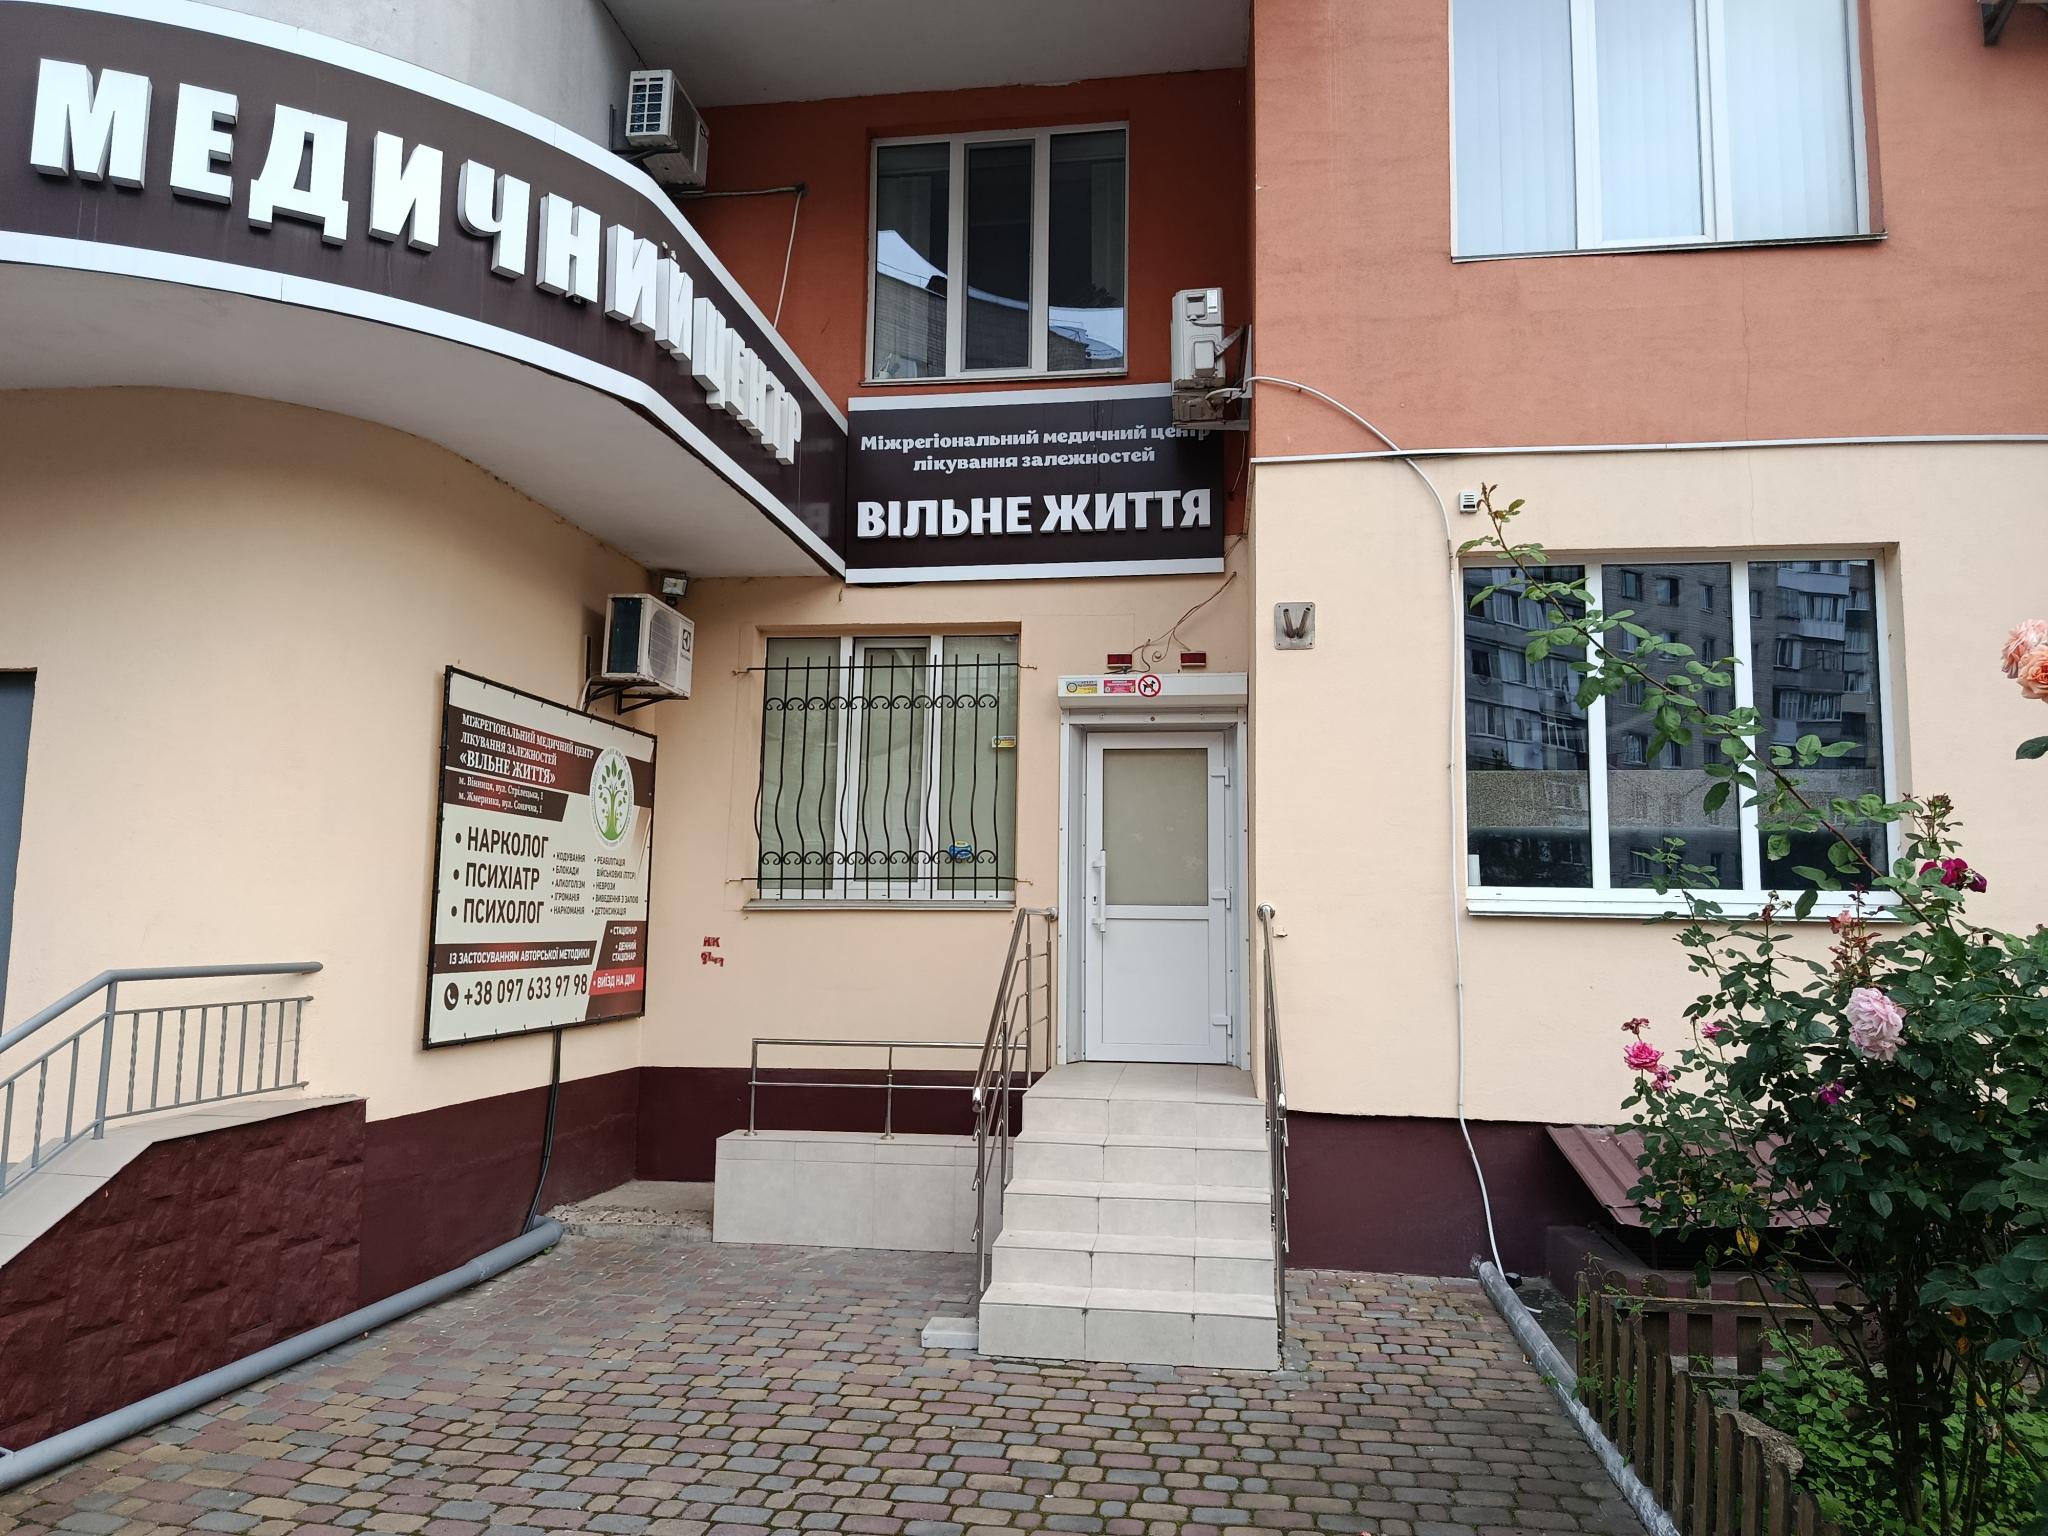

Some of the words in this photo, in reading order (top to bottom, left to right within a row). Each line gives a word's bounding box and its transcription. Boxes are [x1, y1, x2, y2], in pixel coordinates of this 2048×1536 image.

[30, 58, 693, 361] МЕДИЧНИЙ
[692, 297, 802, 465] ЦЕНТР
[861, 430, 1039, 453] Міжрегіональний
[1043, 424, 1148, 446] медичний
[913, 454, 1018, 474] лікування
[1021, 446, 1156, 468] залежностей
[857, 496, 1033, 539] ВІЛЬНЕ
[1040, 488, 1212, 535] ЖИТТЯ
[461, 731, 506, 753] ЛІКУВАННЯ
[506, 743, 557, 766] ЗАЛЕЖНОСТЕЙ
[462, 713, 535, 744] МІЖРЕГІОНАЛЬНИЙ
[536, 733, 574, 754] МЕДИЧНИЙ
[574, 748, 594, 759] ЦЕНТР
[460, 749, 511, 776] «ВІЛЬНЕ
[512, 760, 556, 784] ЖИТТЯ»
[468, 826, 549, 858] НАРКОЛОГ
[466, 862, 540, 890] ПСИХІАТР
[464, 898, 544, 924] ПСИХОЛОГ
[449, 952, 457, 965] ІЗ
[458, 949, 519, 965] ЗАСТОСУВАННЯМ
[520, 946, 559, 964] АВТОРСЬКОЇ
[559, 948, 591, 960] МЕТОДИКИ
[464, 980, 493, 1006] +38
[497, 978, 524, 1004] 097
[527, 976, 551, 1001] 633
[555, 973, 570, 998] 97
[573, 973, 588, 996] 98
